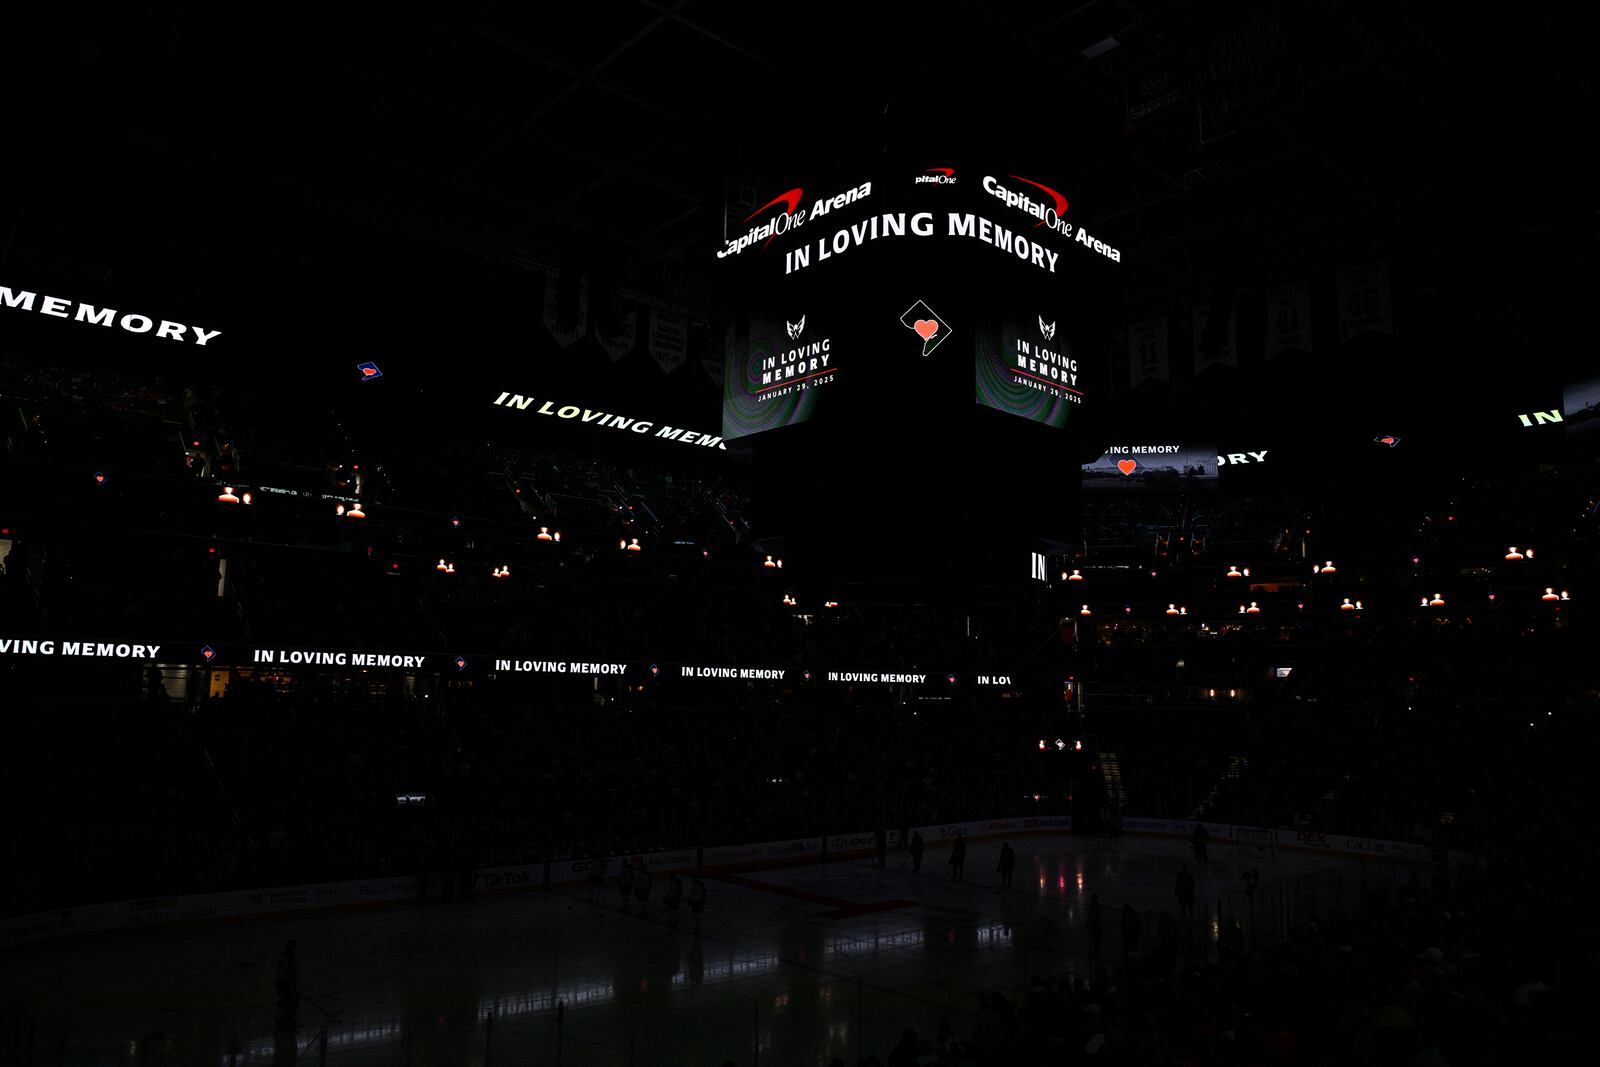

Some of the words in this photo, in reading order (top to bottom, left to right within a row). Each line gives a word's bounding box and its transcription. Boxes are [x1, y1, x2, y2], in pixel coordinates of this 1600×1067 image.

[808, 182, 872, 221] Arena
[785, 244, 811, 275] IN
[818, 212, 934, 259] LOVING
[948, 212, 1059, 273] MEMORY
[1075, 227, 1121, 263] Arena
[0, 285, 222, 346] MEMORY
[762, 356, 776, 371] IN
[781, 338, 830, 364] LOVING
[762, 353, 830, 385] MEMORY
[1017, 338, 1030, 354] IN
[1035, 345, 1077, 372] LOVING
[1017, 354, 1077, 386] MEMORY
[758, 386, 793, 402] JANUARY
[813, 374, 834, 387] 2025
[1013, 375, 1047, 392] JANUARY
[1064, 392, 1082, 404] 2025
[493, 391, 535, 410] IN
[537, 400, 654, 434] LOVING
[1517, 409, 1564, 427] IN
[1105, 446, 1129, 454] ING
[1132, 445, 1180, 454] MEMORY
[62, 641, 161, 659] MEMORY
[253, 649, 275, 663] IN
[279, 650, 347, 666] LOVING
[351, 653, 426, 670] MEMORY
[494, 659, 511, 672] IN
[514, 660, 567, 674] LOVING
[569, 662, 628, 677] MEMORY
[681, 666, 694, 677] IN
[696, 666, 738, 679] LOVING
[740, 668, 786, 681] MEMORY
[828, 671, 839, 682] IN
[840, 672, 879, 683] LOVING
[881, 673, 927, 684] MEMORY
[977, 675, 990, 685] IN
